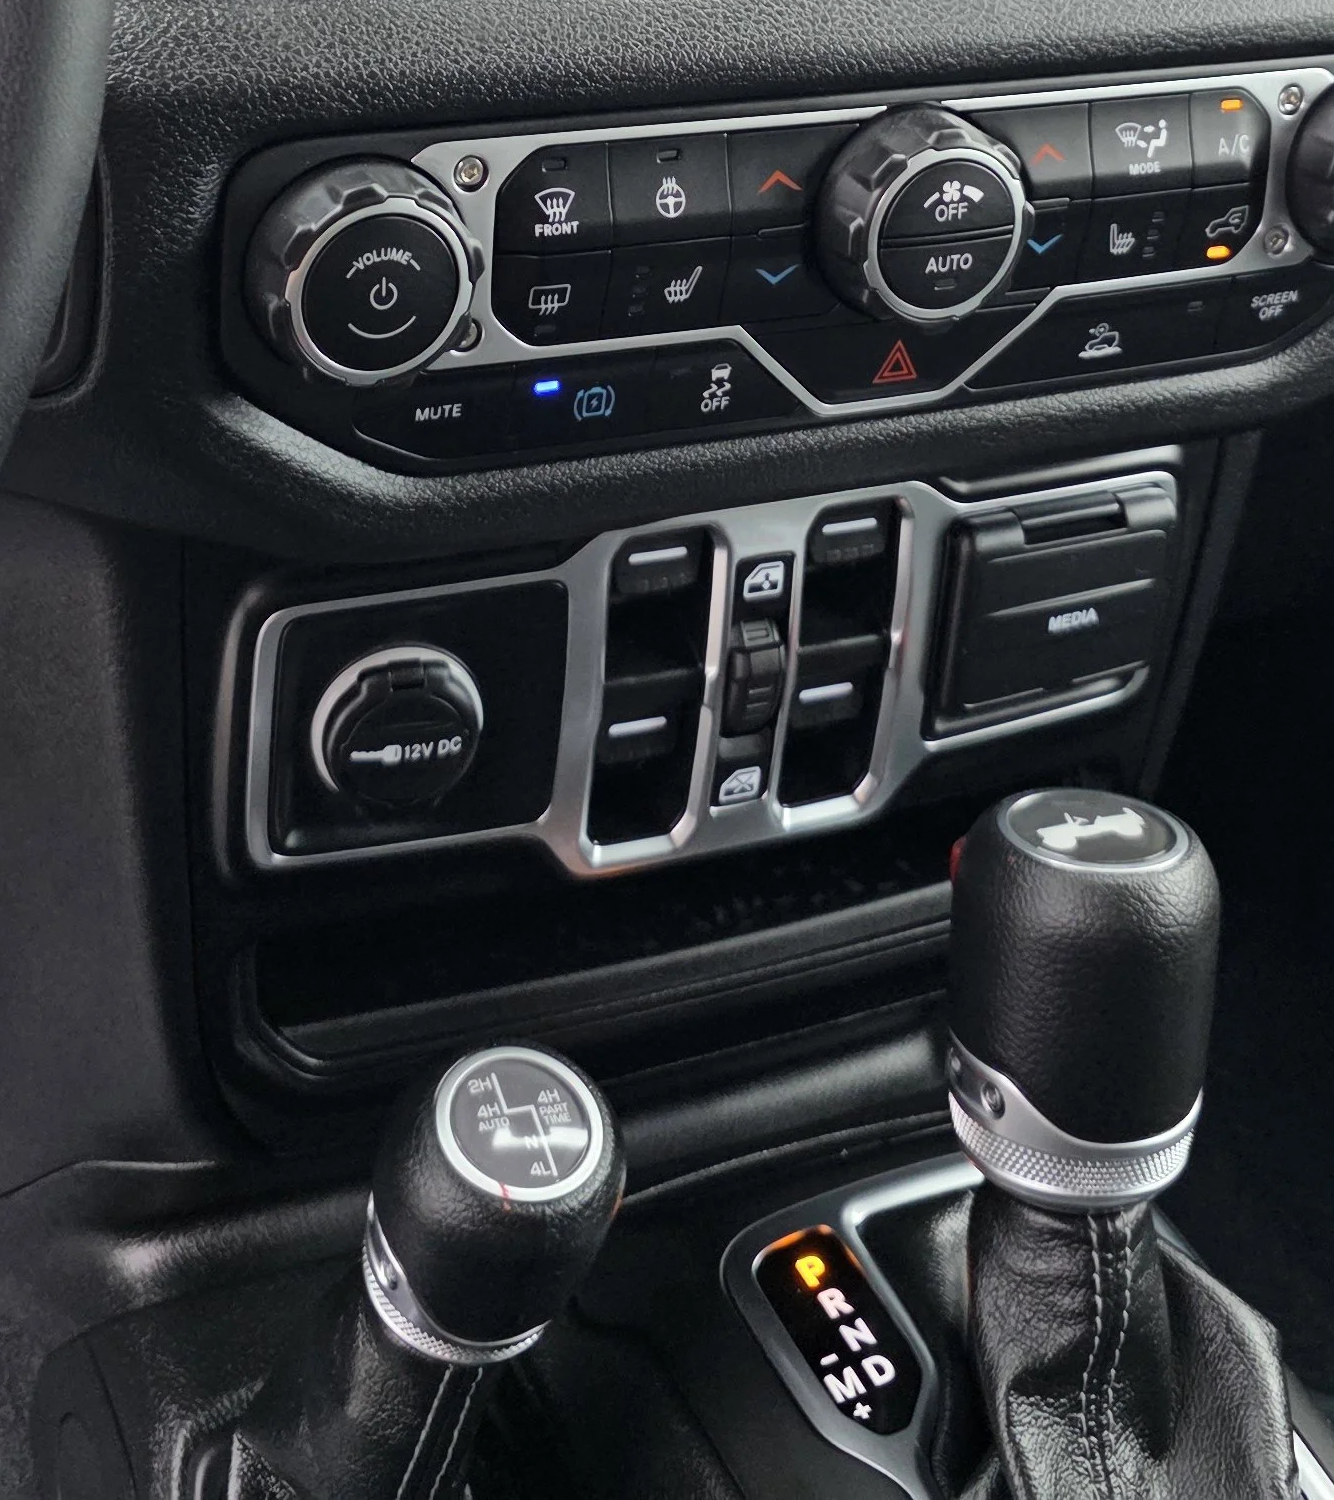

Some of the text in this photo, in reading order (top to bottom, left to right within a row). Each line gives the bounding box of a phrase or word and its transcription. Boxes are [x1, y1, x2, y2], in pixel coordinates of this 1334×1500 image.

[1218, 134, 1250, 156] A/C
[1129, 160, 1161, 176] MODE
[934, 202, 968, 222] OFF
[534, 221, 579, 237] FRONT
[352, 247, 412, 270] VOLUME
[925, 252, 972, 275] AUTO
[1251, 290, 1298, 308] SCREEN
[1258, 305, 1283, 321] OFF
[415, 403, 462, 422] MUTE
[700, 395, 730, 413] OFF
[1047, 608, 1099, 631] MEDIA
[403, 737, 463, 761] 12V DC
[468, 1076, 492, 1093] 2H
[537, 1089, 561, 1103] 4H
[477, 1102, 500, 1117] 4H
[539, 1102, 568, 1117] PART
[478, 1116, 509, 1132] AUTO
[543, 1113, 571, 1125] TIME
[530, 1161, 551, 1176] 4L
[795, 1255, 826, 1288] P
[817, 1287, 855, 1319] R
[838, 1317, 878, 1352] N
[861, 1354, 896, 1387] D
[823, 1365, 867, 1404] M
